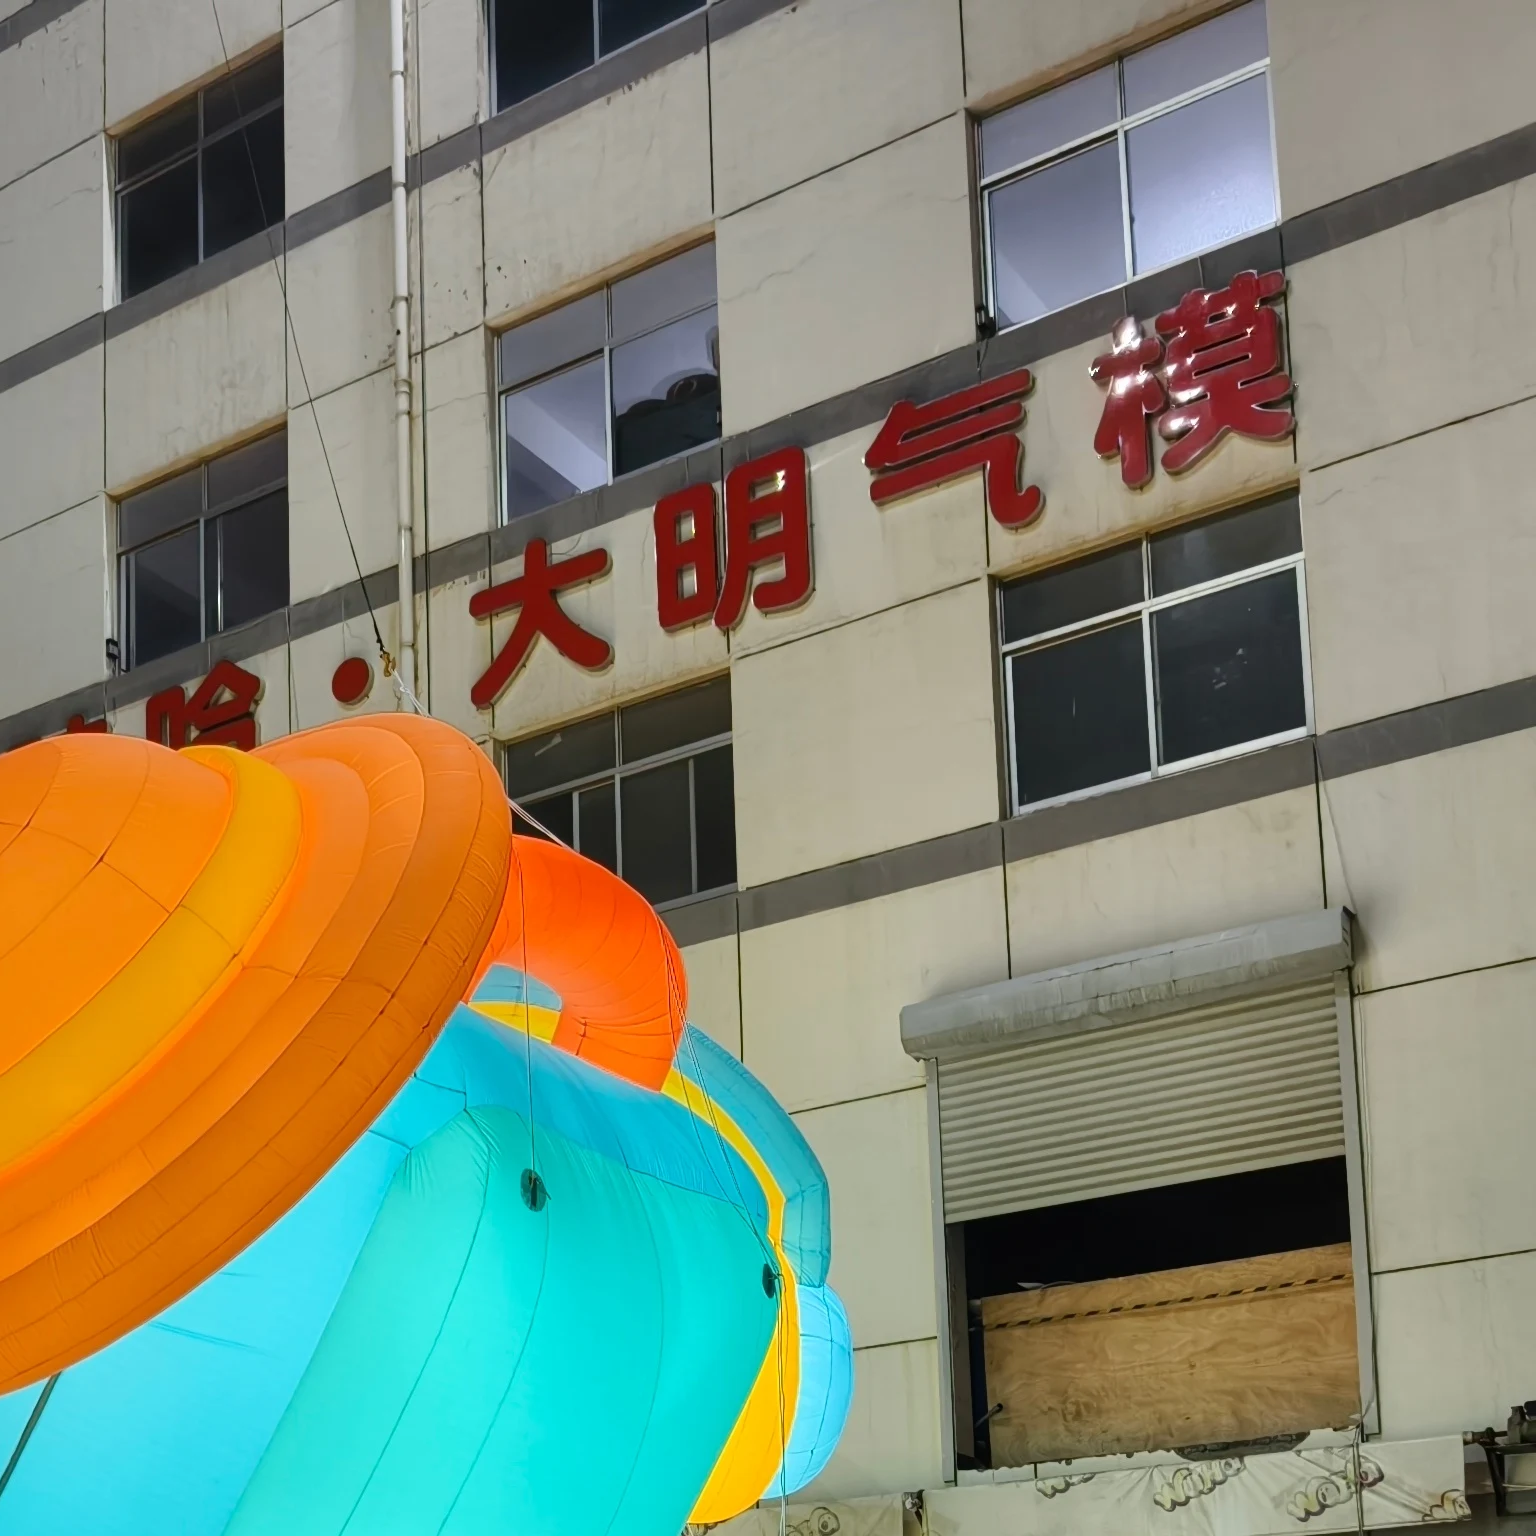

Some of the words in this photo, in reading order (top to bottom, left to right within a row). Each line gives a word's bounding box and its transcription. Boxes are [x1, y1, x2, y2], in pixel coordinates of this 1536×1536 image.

[7, 270, 1297, 752] 哈·大明气模
